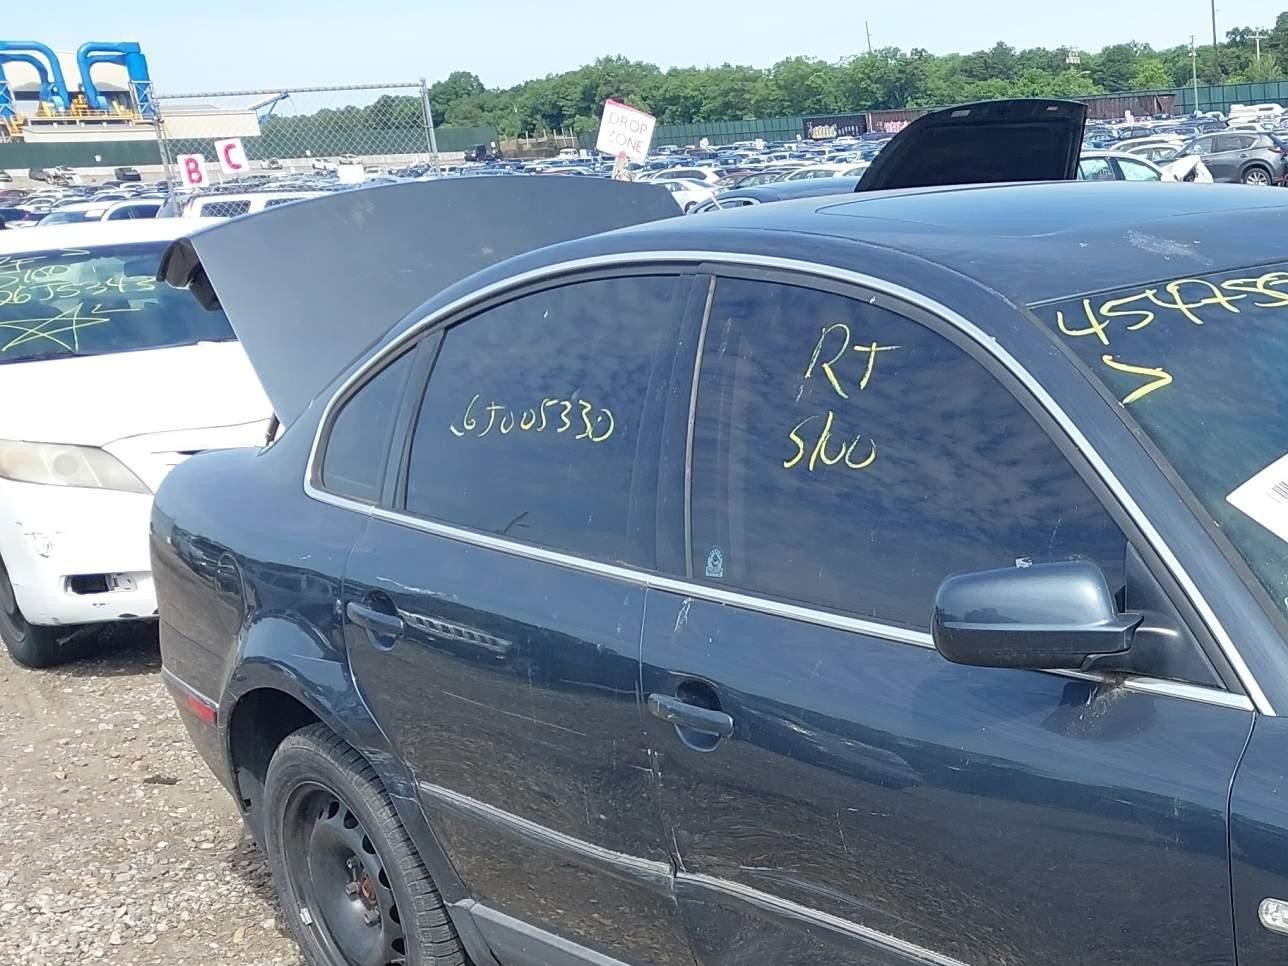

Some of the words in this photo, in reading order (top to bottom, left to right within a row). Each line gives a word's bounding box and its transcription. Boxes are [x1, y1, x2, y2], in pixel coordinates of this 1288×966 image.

[609, 111, 647, 134] DROP
[223, 143, 242, 170] C
[183, 157, 203, 184] B
